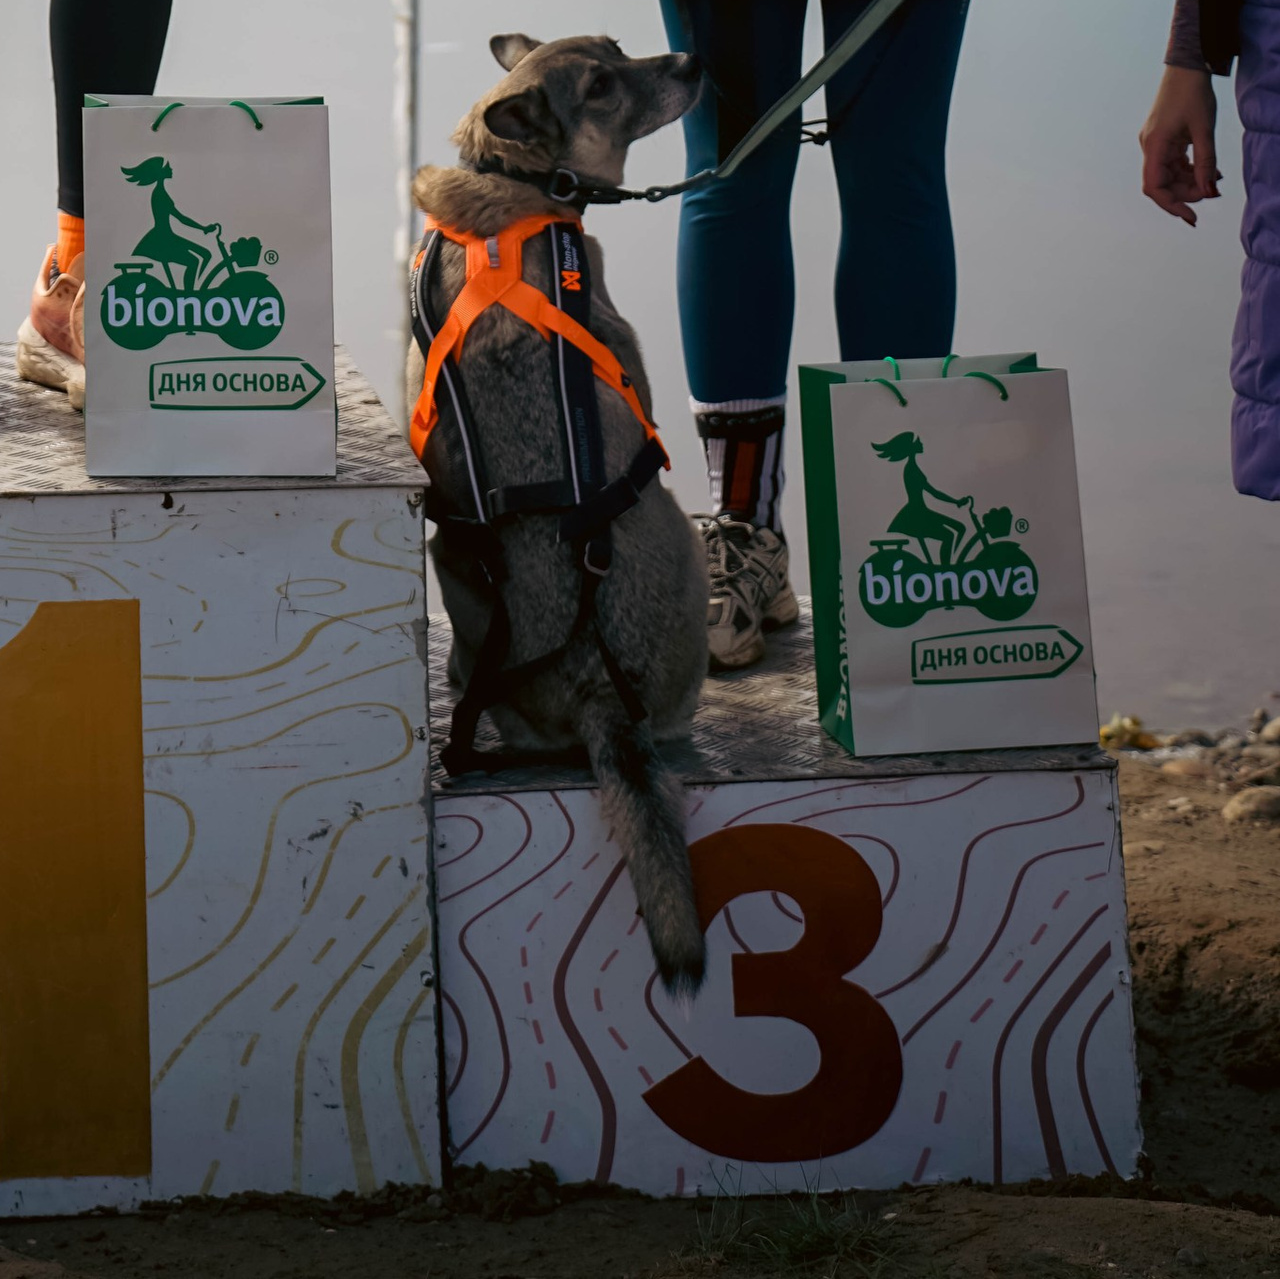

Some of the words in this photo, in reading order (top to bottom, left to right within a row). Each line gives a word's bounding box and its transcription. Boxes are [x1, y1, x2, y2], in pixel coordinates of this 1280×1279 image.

[106, 282, 282, 328] bionova
[158, 373, 206, 395] ДНЯ
[212, 372, 307, 393] ОСНОВА
[863, 559, 1037, 606] bionova
[920, 647, 967, 671] ДНЯ
[973, 640, 1066, 667] ОСНОВА
[641, 823, 905, 1163] 3
